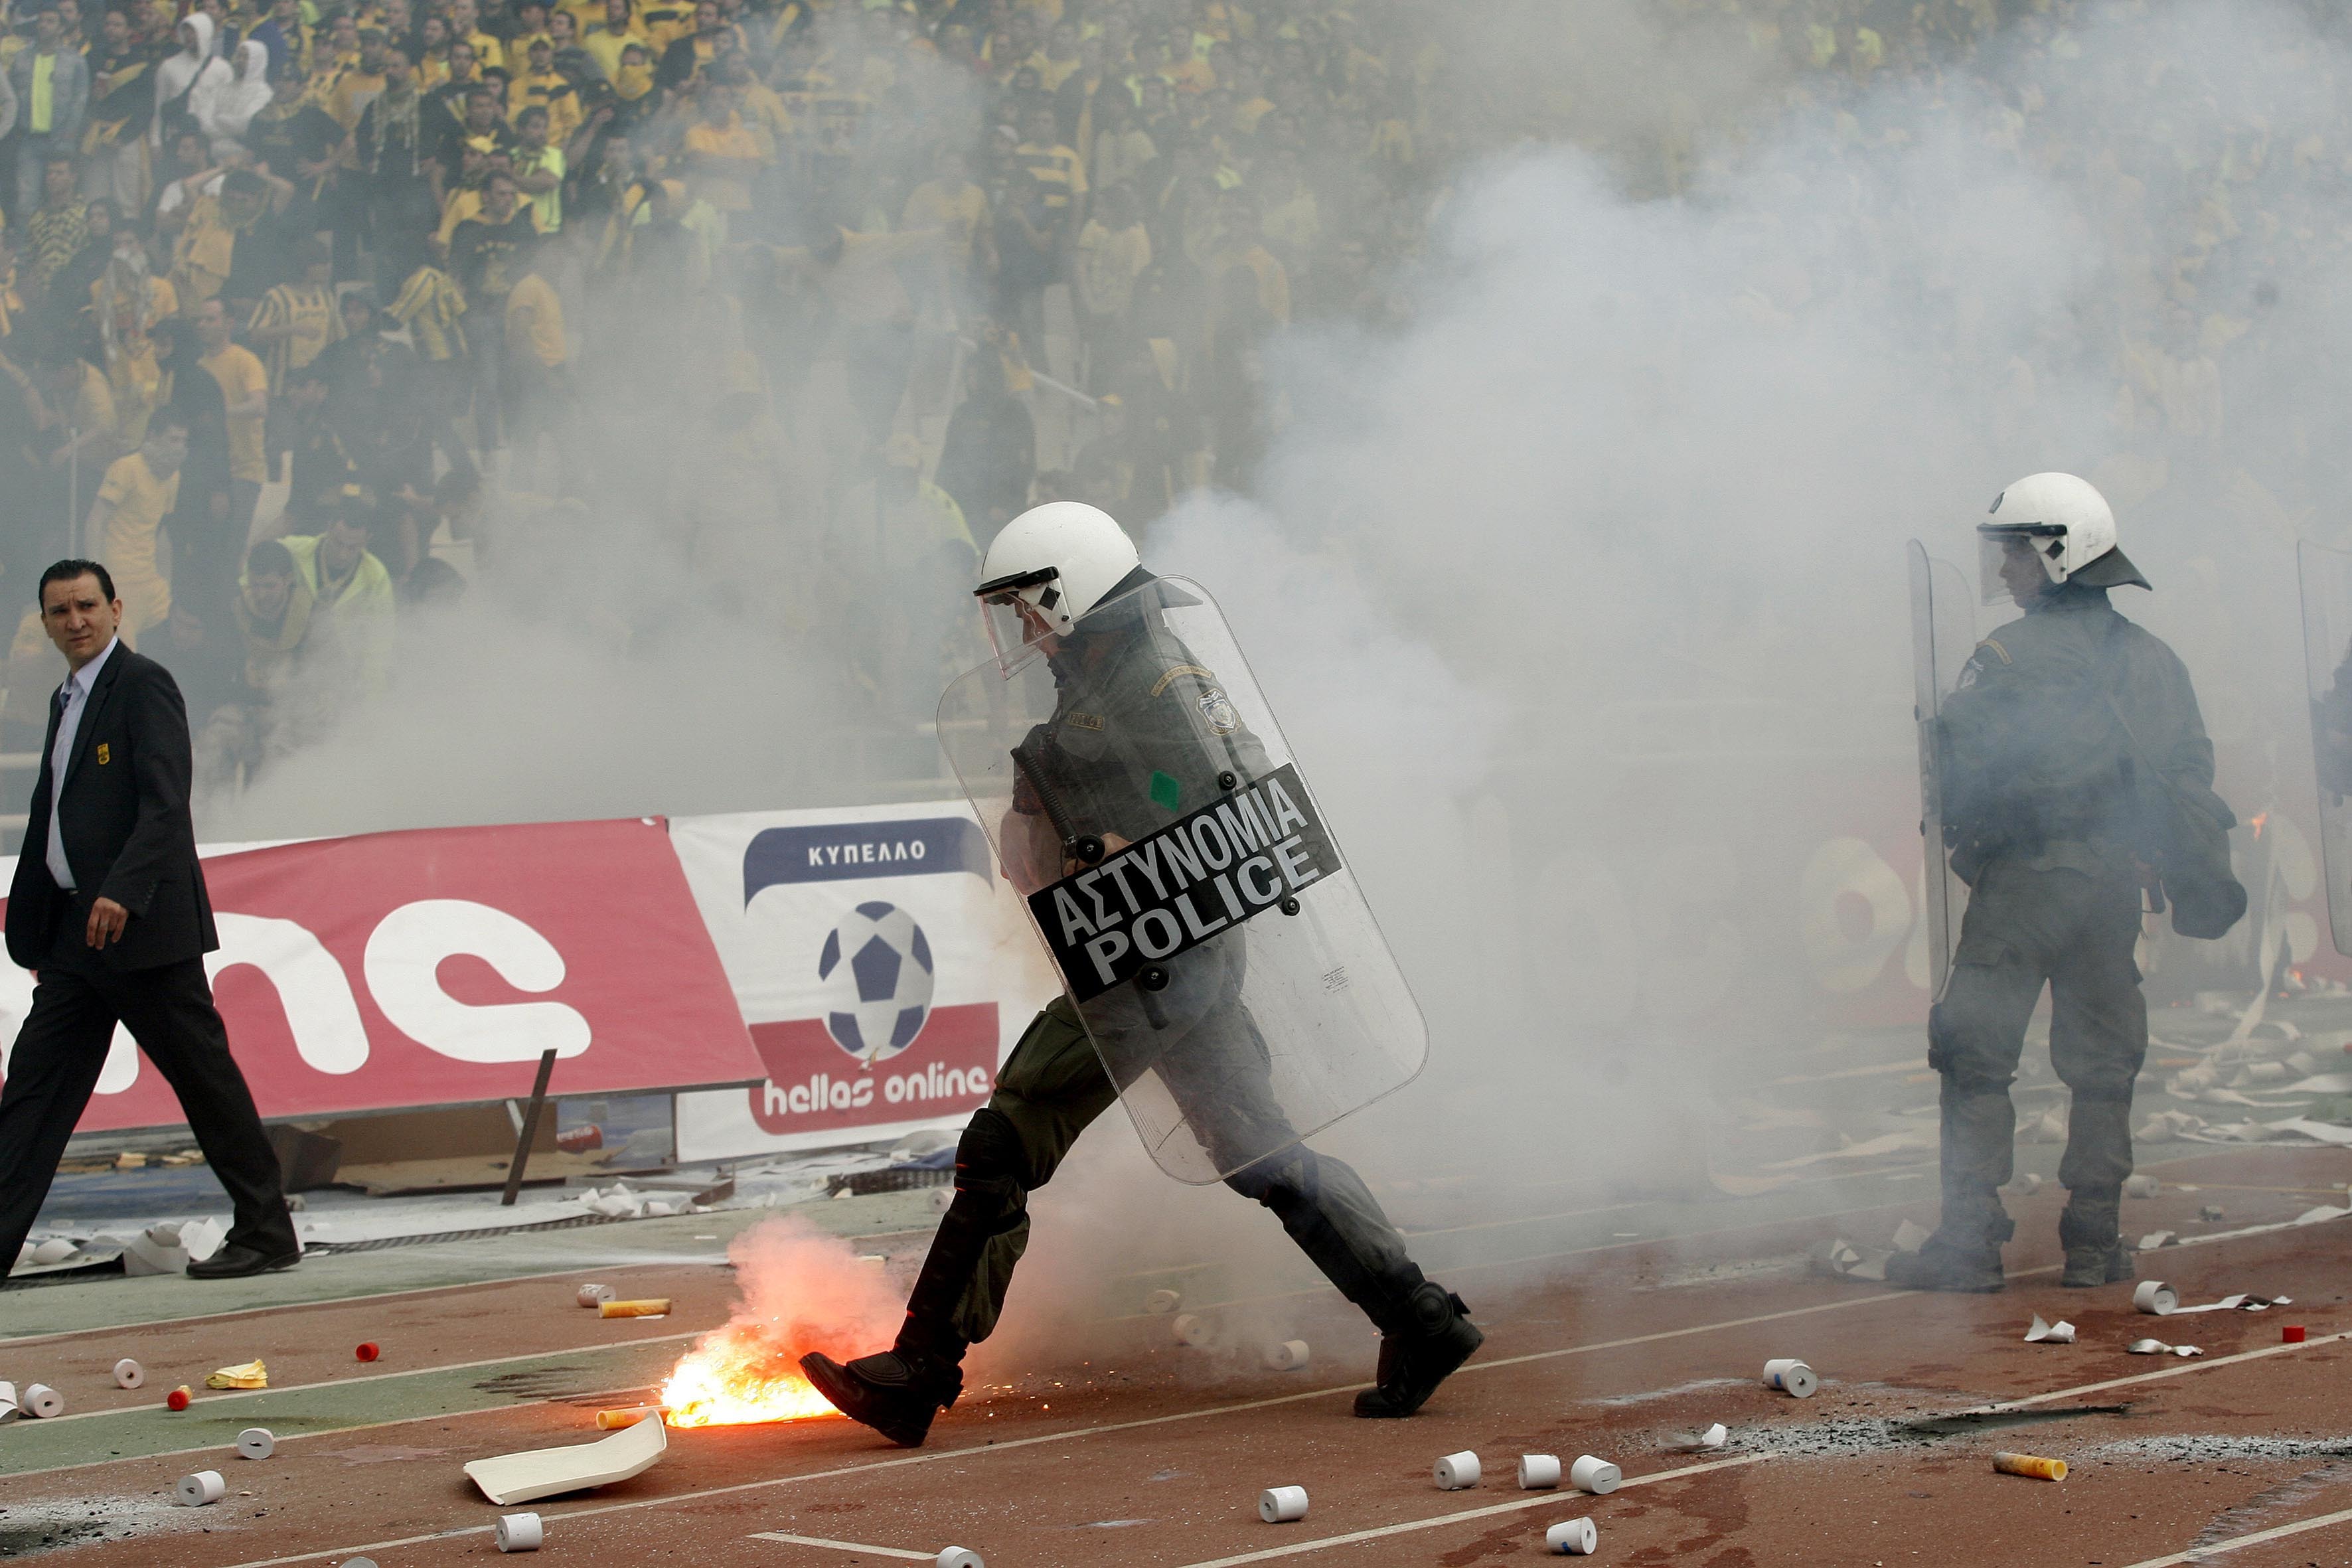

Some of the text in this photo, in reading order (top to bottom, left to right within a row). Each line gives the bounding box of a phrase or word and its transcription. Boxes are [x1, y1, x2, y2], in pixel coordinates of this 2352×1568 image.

[809, 840, 926, 866] ΚΥΠΕΛΛΟ
[1054, 777, 1308, 947] ΑΣΤΥΝΟΜΙΑ
[1085, 834, 1319, 985] POLICE
[764, 1063, 990, 1117] hellas online
